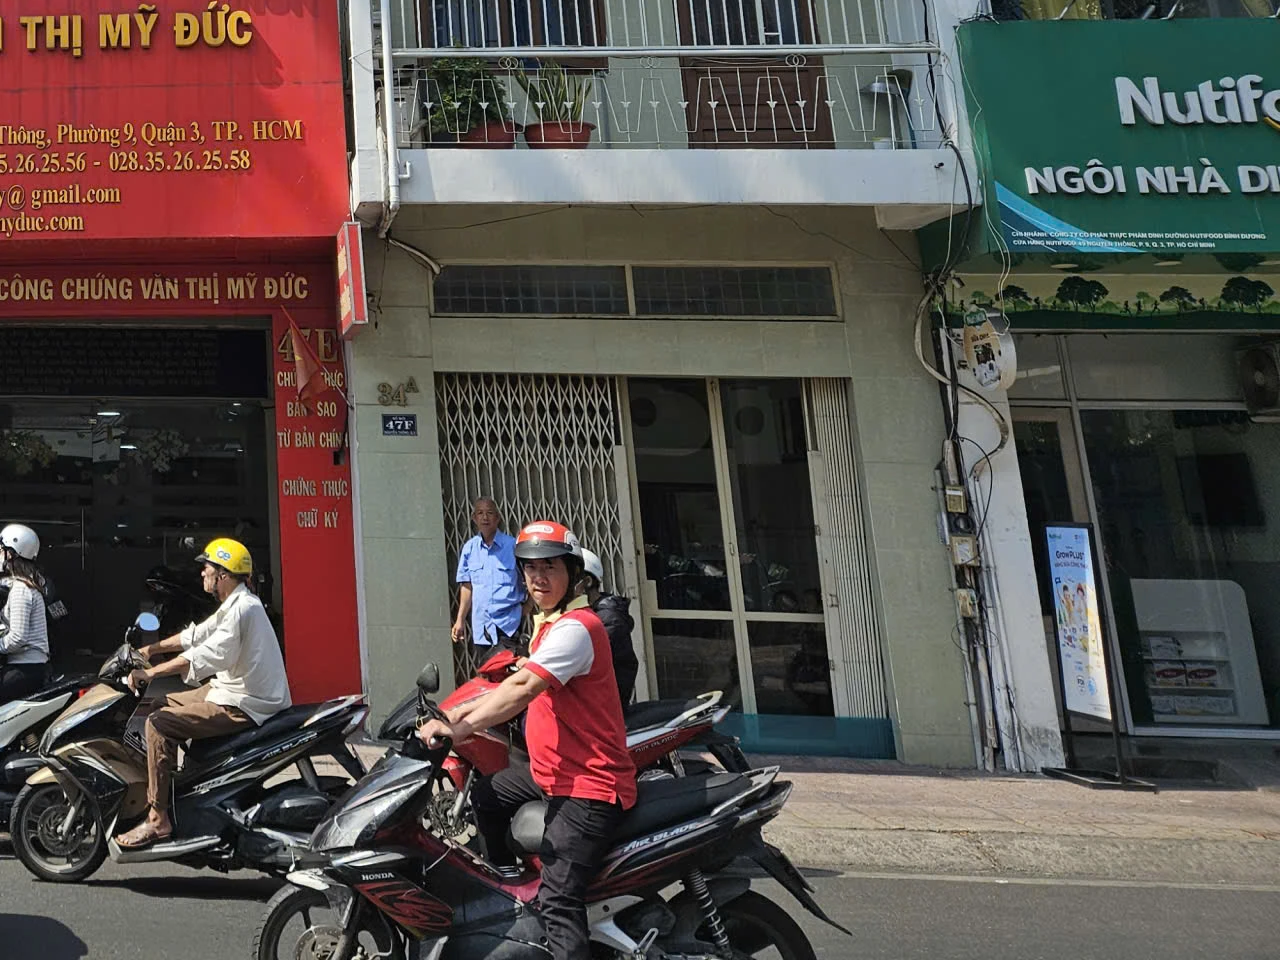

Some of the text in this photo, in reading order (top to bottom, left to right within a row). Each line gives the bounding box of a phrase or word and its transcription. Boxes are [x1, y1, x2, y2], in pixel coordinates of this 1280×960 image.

[21, 13, 83, 58] THỊ
[99, 3, 159, 49] MỸ
[173, 0, 253, 48] ĐỨC
[57, 123, 119, 147] Phường
[123, 122, 137, 146] 9,
[141, 121, 186, 147] Quận
[190, 121, 205, 144] 3,
[211, 121, 243, 141] TP.
[252, 119, 303, 141] HCM
[108, 149, 252, 172] 028.35.26.25.58
[1024, 157, 1280, 194] NGÔI NHÀ DI
[31, 184, 121, 209] gmail.com
[62, 273, 133, 300] CHỨNG
[140, 273, 179, 300] VĂN
[185, 272, 219, 304] THỊ
[226, 273, 258, 299] MỸ
[264, 271, 309, 299] ĐỨC
[317, 402, 337, 417] SAO
[385, 420, 414, 430] 47F
[277, 427, 291, 448] TỪ
[295, 426, 316, 448] BẢN
[282, 476, 348, 499] CHỨNG THỰC
[297, 508, 338, 528] CHỮ KÝ
[361, 872, 395, 881] HONDA
